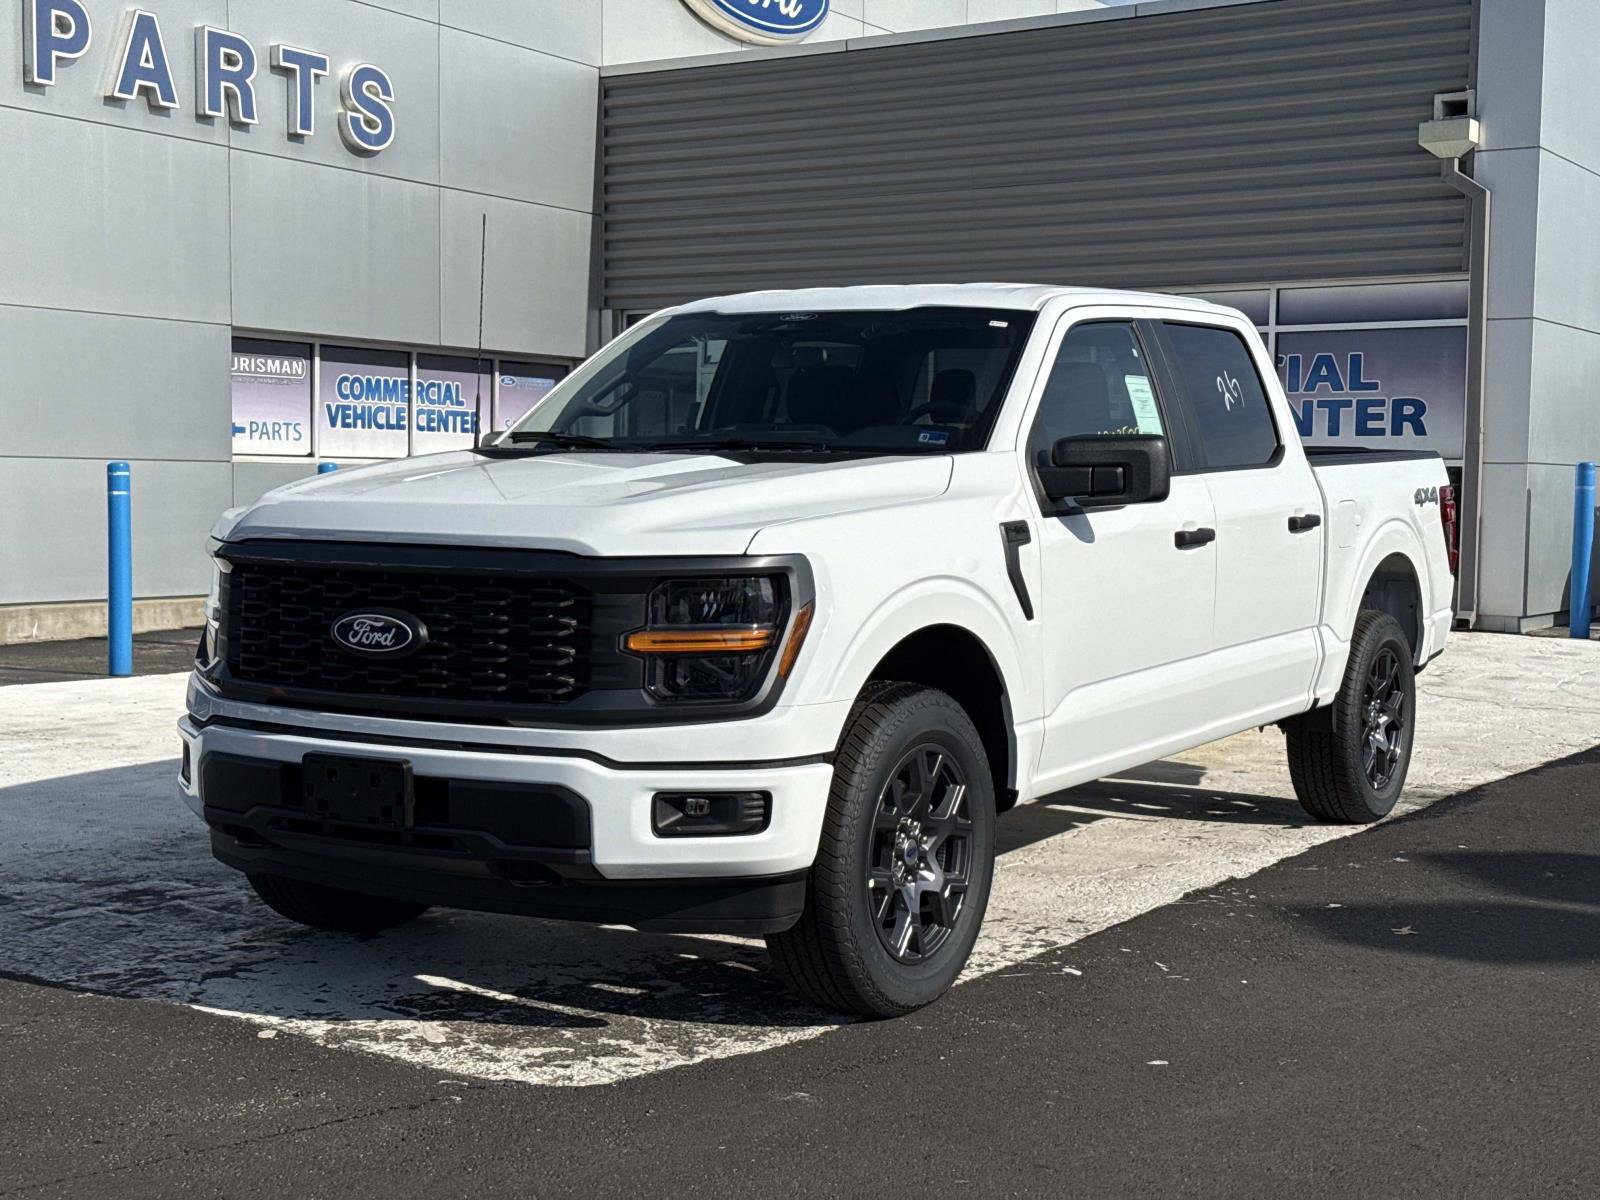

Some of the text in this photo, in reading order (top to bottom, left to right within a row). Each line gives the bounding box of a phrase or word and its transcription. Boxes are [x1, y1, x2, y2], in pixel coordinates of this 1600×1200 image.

[24, 0, 395, 152] PARTS
[336, 374, 465, 407] COMMERCIAL
[249, 421, 302, 441] PARTS
[325, 402, 407, 431] VEHICLE
[348, 618, 396, 646] Ford
